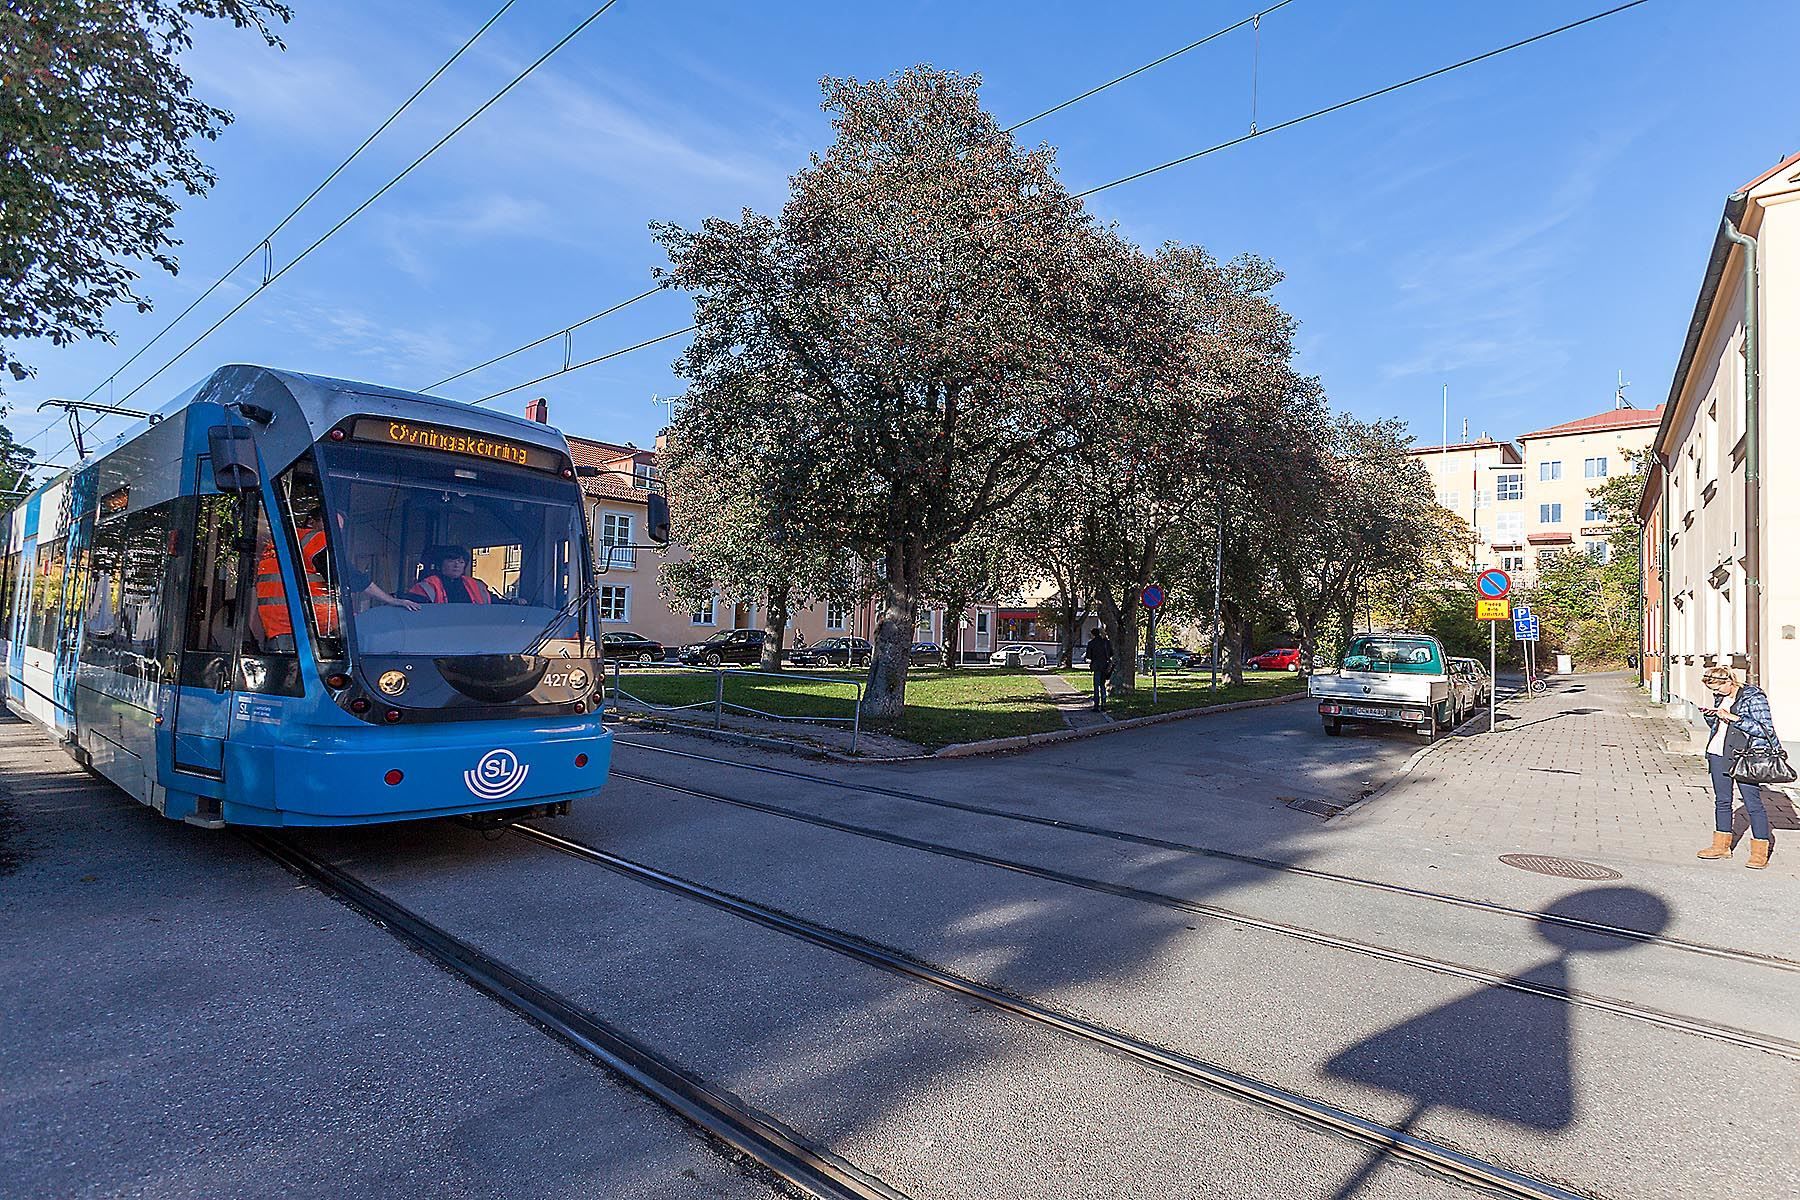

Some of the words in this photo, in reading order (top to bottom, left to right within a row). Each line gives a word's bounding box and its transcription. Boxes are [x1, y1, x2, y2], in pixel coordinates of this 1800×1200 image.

[389, 422, 528, 464] Övningskörning
[1518, 609, 1527, 619] P
[543, 673, 568, 687] 427
[239, 703, 249, 714] SL
[484, 758, 511, 778] SL
